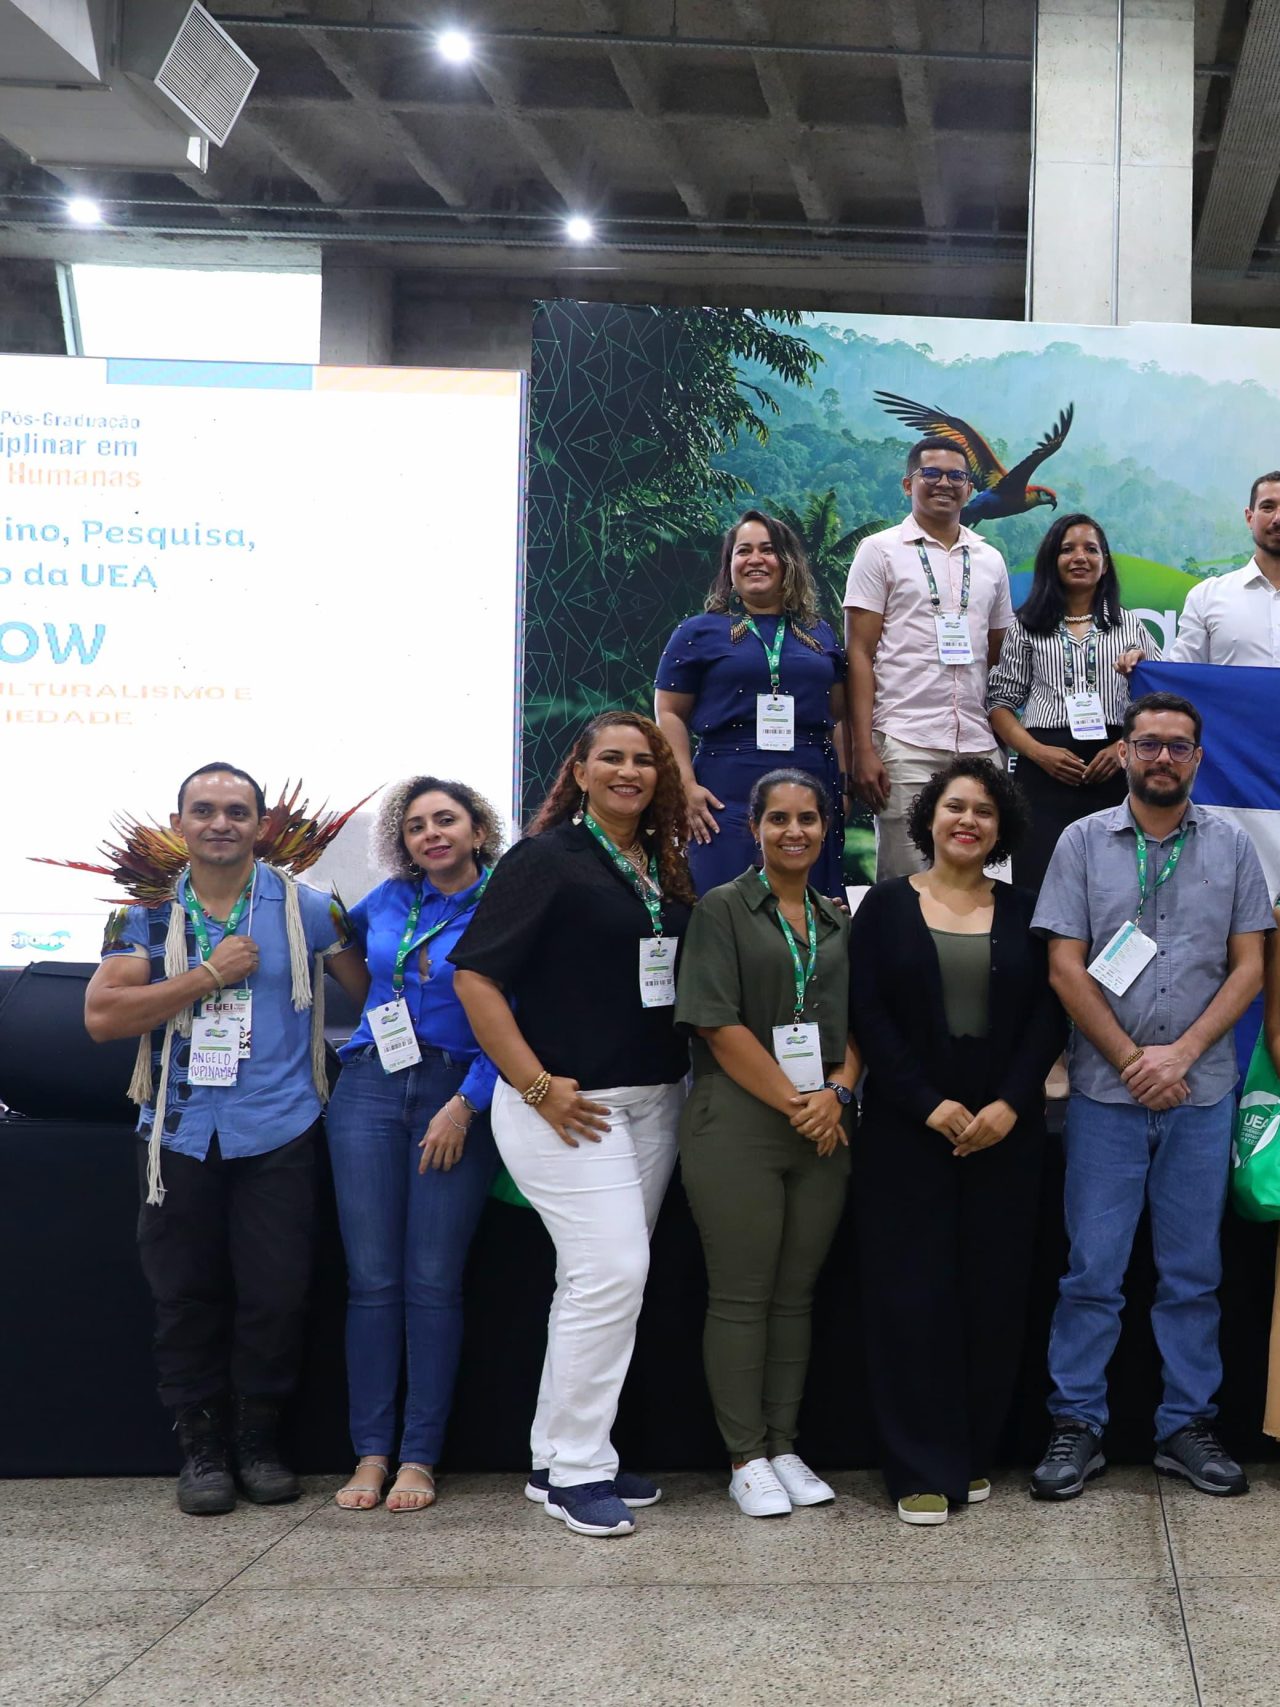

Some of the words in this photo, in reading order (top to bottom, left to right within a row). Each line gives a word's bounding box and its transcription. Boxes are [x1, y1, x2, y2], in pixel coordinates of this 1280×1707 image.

[98, 440, 137, 456] em
[8, 462, 142, 488] Humanas
[82, 520, 255, 551] Pesquisa,
[24, 562, 68, 586] da
[81, 563, 158, 588] UEA
[234, 687, 252, 700] E
